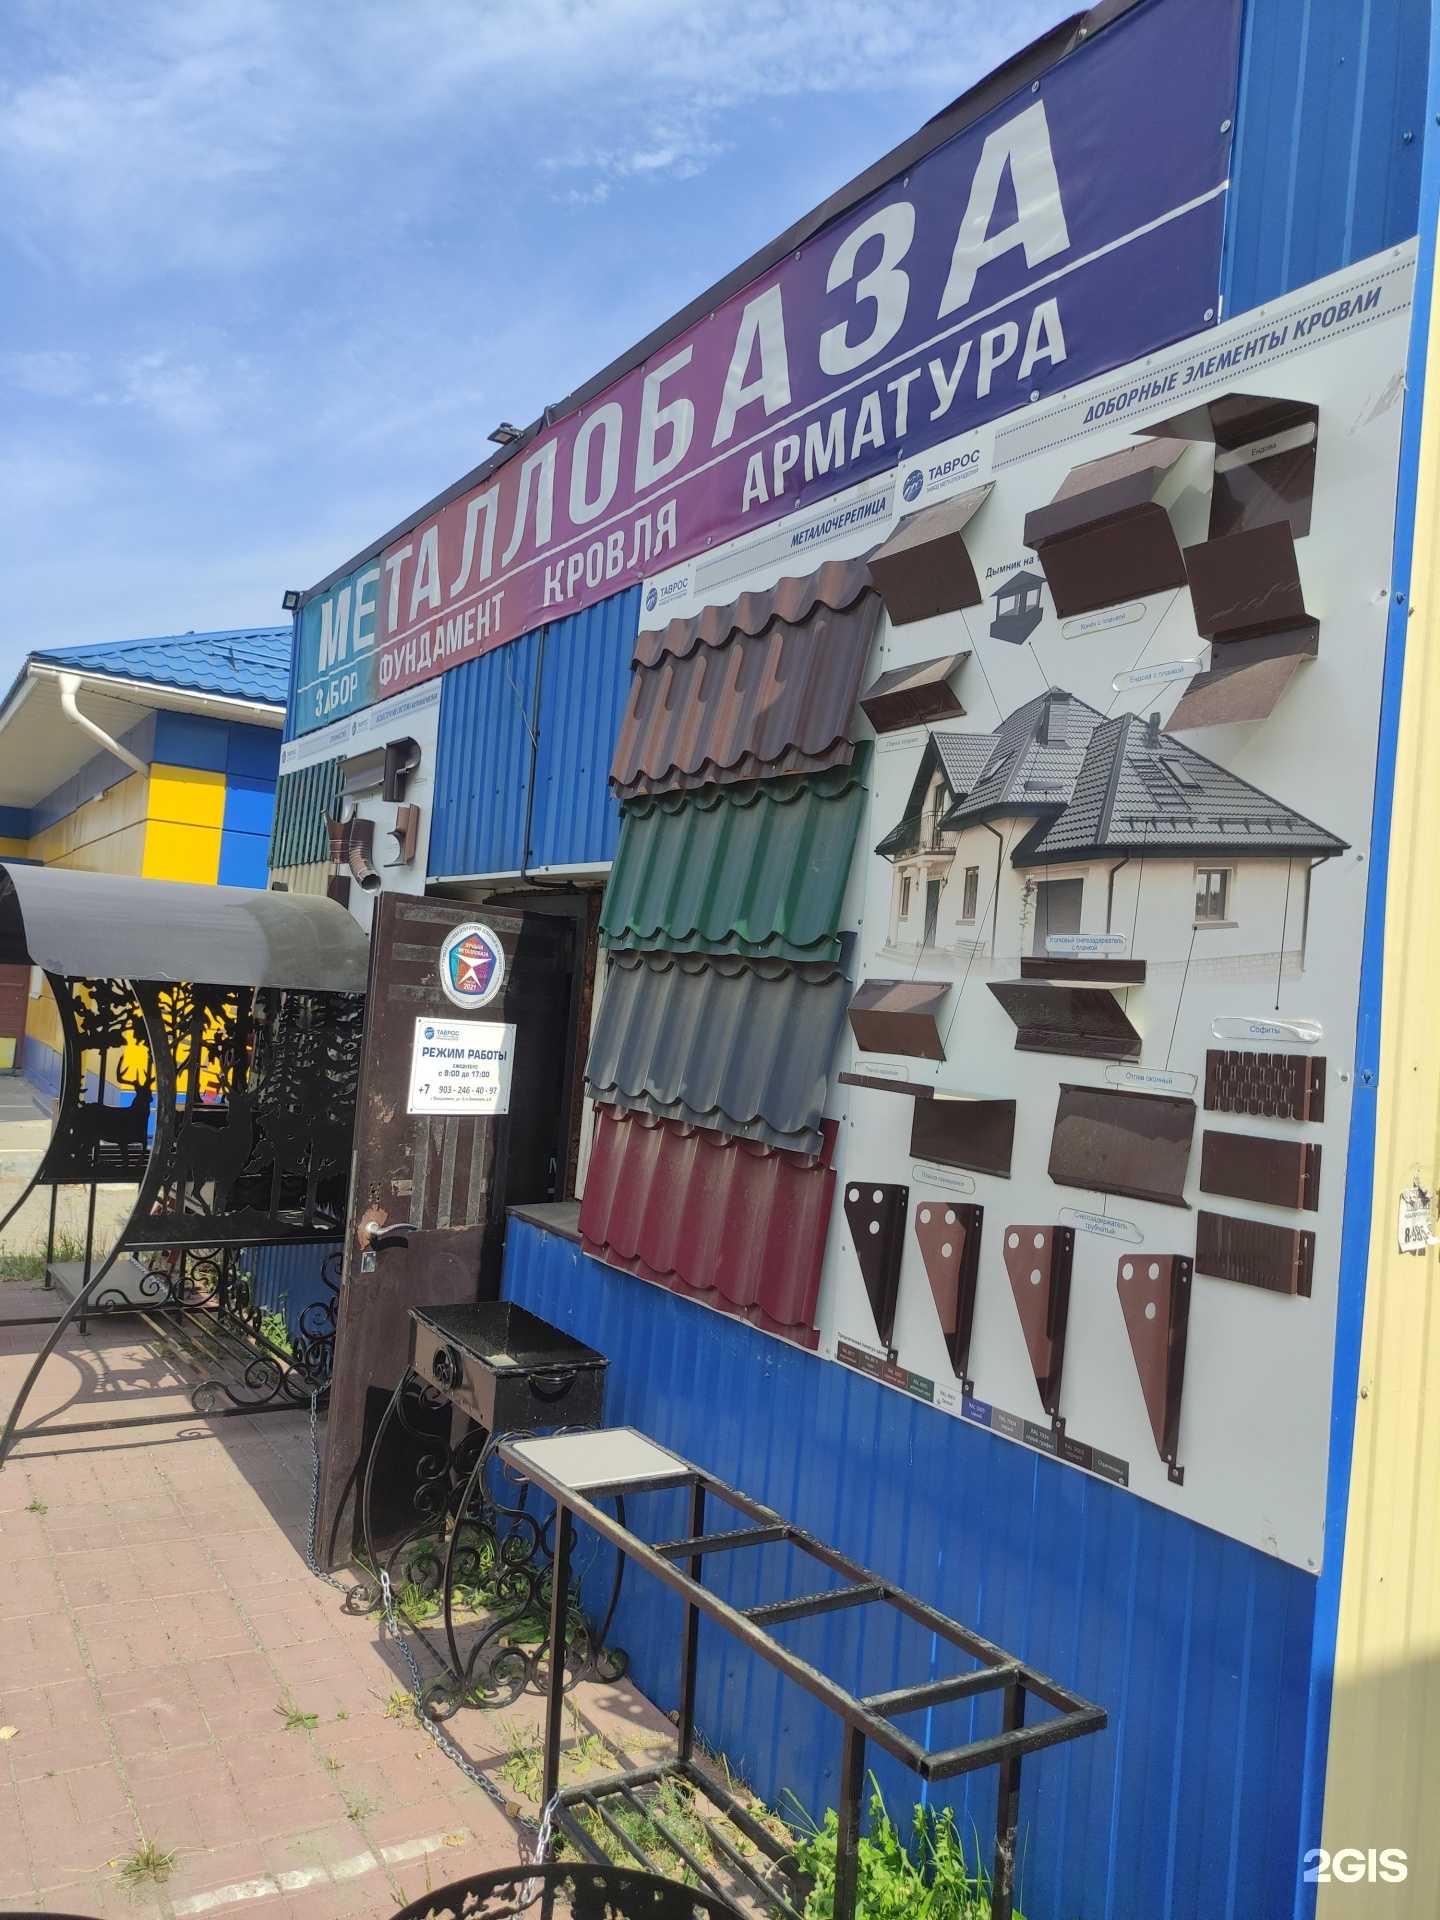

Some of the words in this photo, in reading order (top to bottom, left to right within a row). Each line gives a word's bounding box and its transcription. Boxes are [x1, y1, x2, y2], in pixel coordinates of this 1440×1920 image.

[1082, 370, 1180, 425] ДОБОРНЫЕ
[1181, 332, 1288, 387] ЭЛЕМЕНТЫ
[1292, 286, 1384, 341] КРОВЛИ
[317, 98, 1070, 673] МЕТАЛЛОБАЗА
[928, 449, 981, 481] ТАВРОС
[314, 671, 358, 717] ЗАБОР
[378, 590, 507, 688] ФУНДАМЕНТ
[542, 499, 678, 608] КРОВЛЯ
[740, 296, 1068, 513] АРМАТУРА
[790, 496, 887, 549] МЕТАЛЛОЧЕРЕПИЦА
[985, 559, 1022, 580] Дымник
[1023, 556, 1035, 568] на
[659, 577, 689, 598] ТАВРОС
[436, 1029, 460, 1037] ТАВРОС
[1249, 1023, 1281, 1035] Софиты
[422, 1046, 465, 1059] РЕЖИМ
[468, 1049, 507, 1061] РАБОТЫ
[461, 1071, 470, 1079] до
[471, 1071, 490, 1079] 17:00
[418, 1083, 430, 1095] +7
